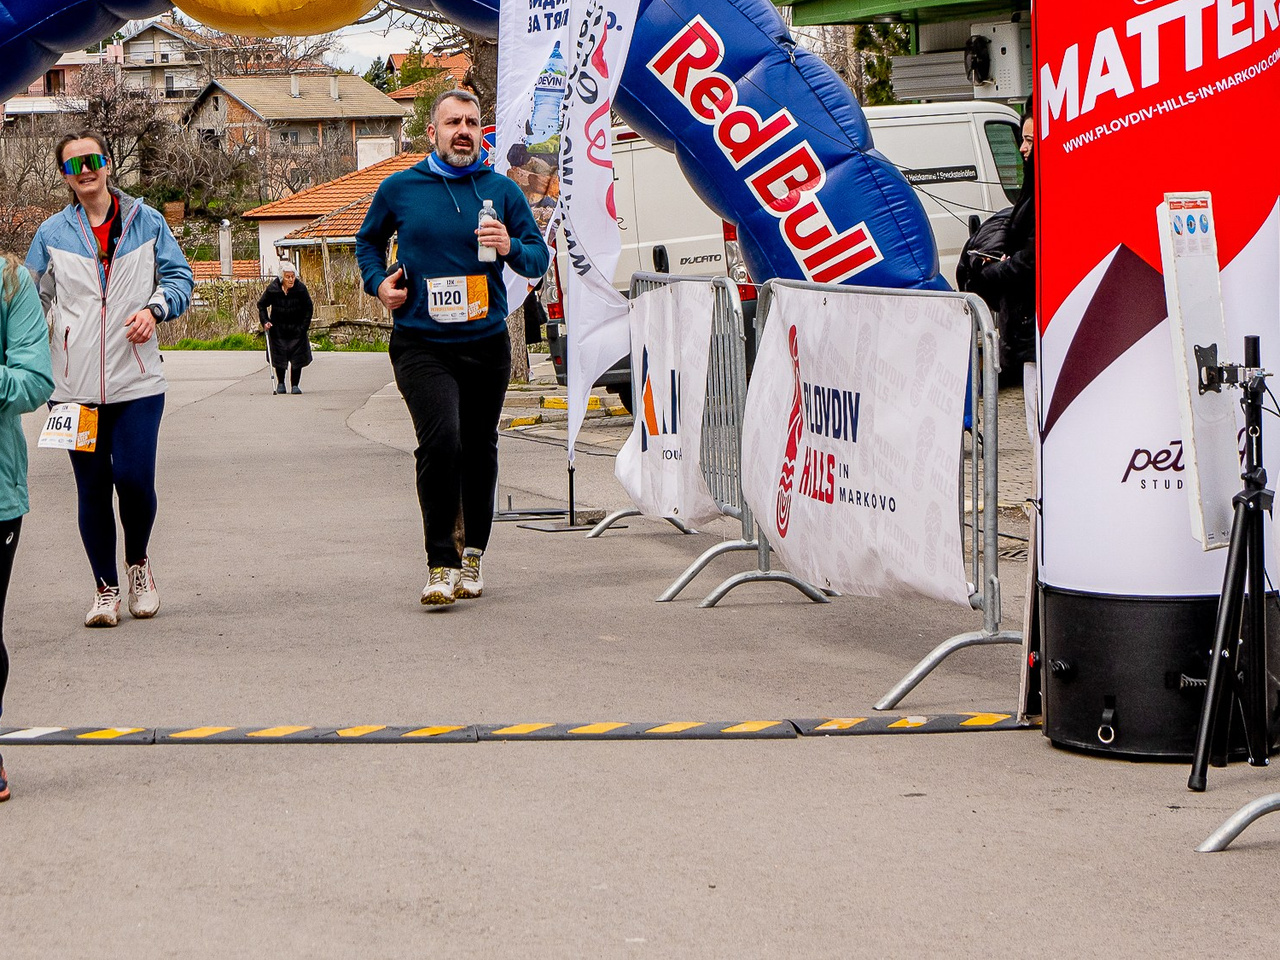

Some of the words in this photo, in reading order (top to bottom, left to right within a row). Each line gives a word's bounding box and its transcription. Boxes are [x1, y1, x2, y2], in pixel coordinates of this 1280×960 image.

[527, 14, 541, 33] ЗА
[543, 8, 570, 31] ТЯЛ
[537, 76, 563, 87] DEVIN
[651, 18, 793, 164] Red
[749, 144, 879, 284] Bull
[679, 253, 722, 266] DUCATO
[431, 290, 462, 306] 1120
[803, 381, 861, 443] PLOVDIV
[46, 416, 72, 431] 1164
[798, 445, 836, 505] HILLS
[839, 462, 849, 479] IN
[1140, 479, 1184, 490] STUD
[839, 486, 896, 513] MARKOVO
